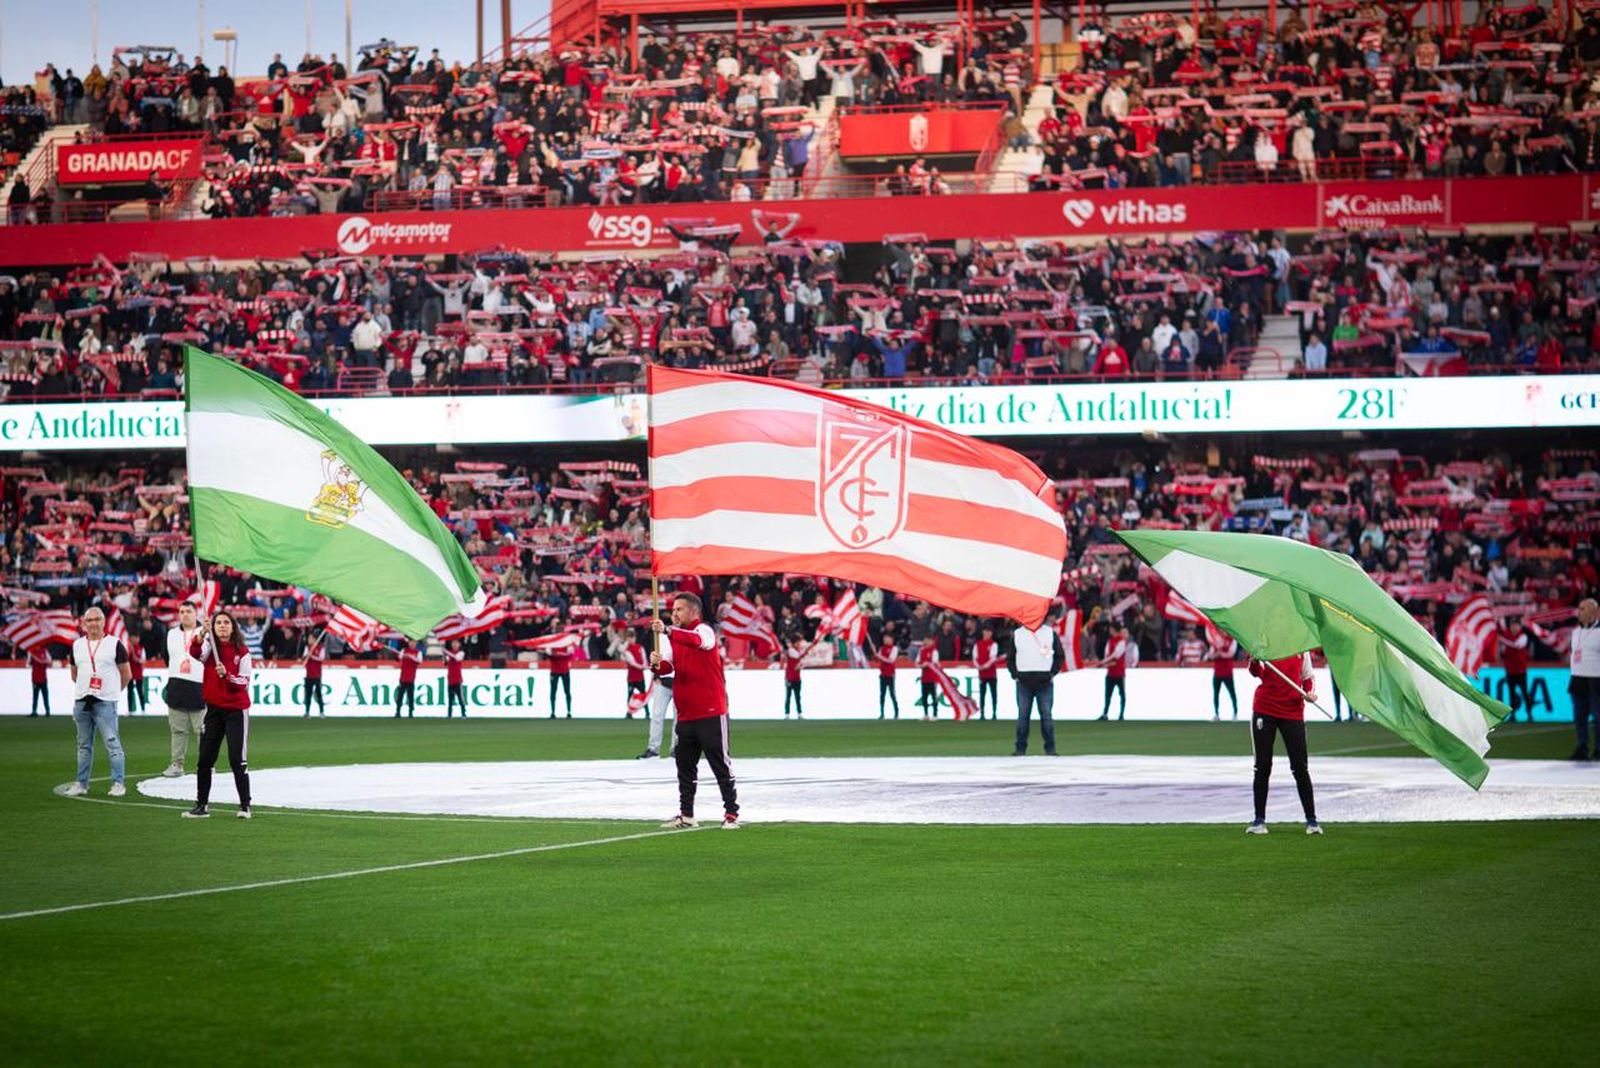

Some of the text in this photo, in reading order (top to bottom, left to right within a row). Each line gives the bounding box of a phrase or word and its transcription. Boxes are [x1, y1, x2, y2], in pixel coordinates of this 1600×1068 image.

[1100, 199, 1187, 224] vithas
[1349, 194, 1443, 215] CaixaBank
[369, 222, 452, 238] micamotor
[937, 393, 986, 424] día
[996, 394, 1036, 423] de
[1048, 388, 1232, 422] Andalucía!
[27, 407, 187, 440] Andalucía
[341, 674, 535, 706] Analcía!
